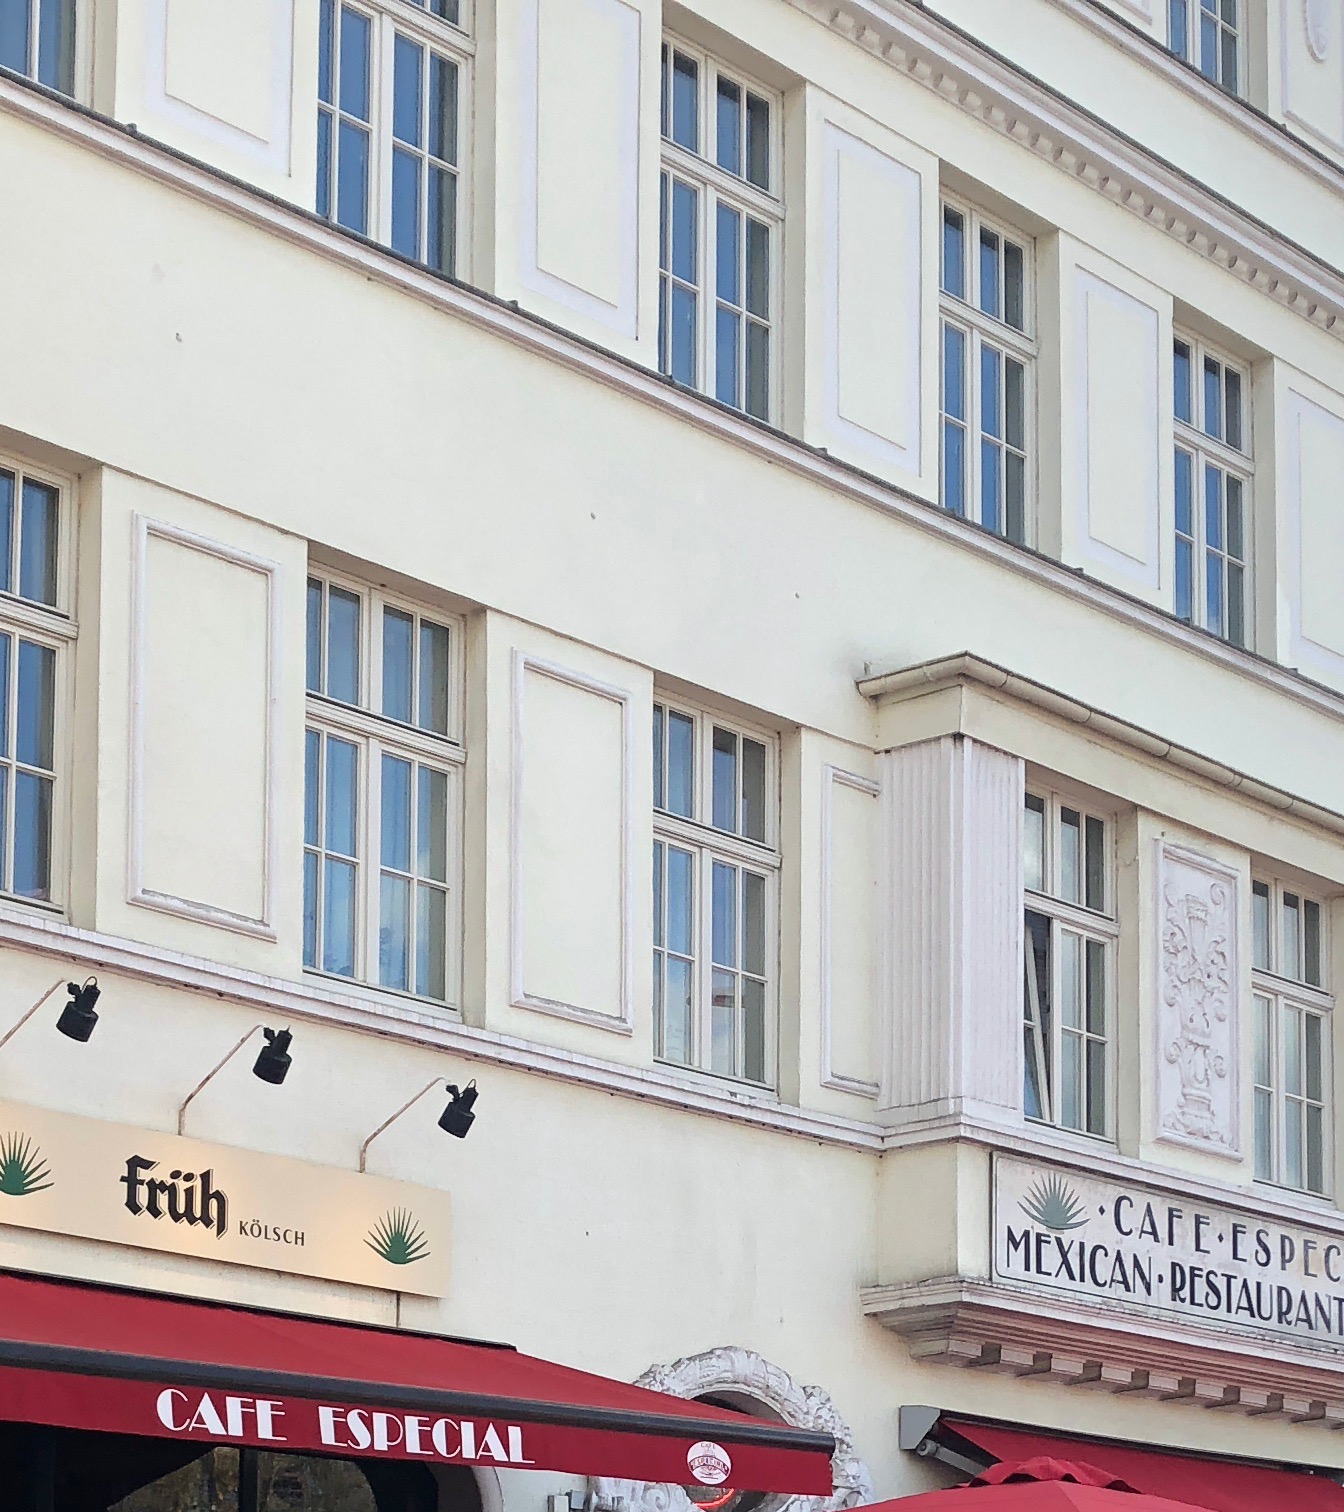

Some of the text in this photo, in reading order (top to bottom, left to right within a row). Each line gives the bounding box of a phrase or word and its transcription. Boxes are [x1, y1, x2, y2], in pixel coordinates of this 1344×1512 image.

[238, 1218, 306, 1247] KÖLSCH
[1113, 1195, 1211, 1255] CAFE
[1006, 1225, 1152, 1297] MEXICAN
[155, 1388, 536, 1465] CAFE ESPECIAL
